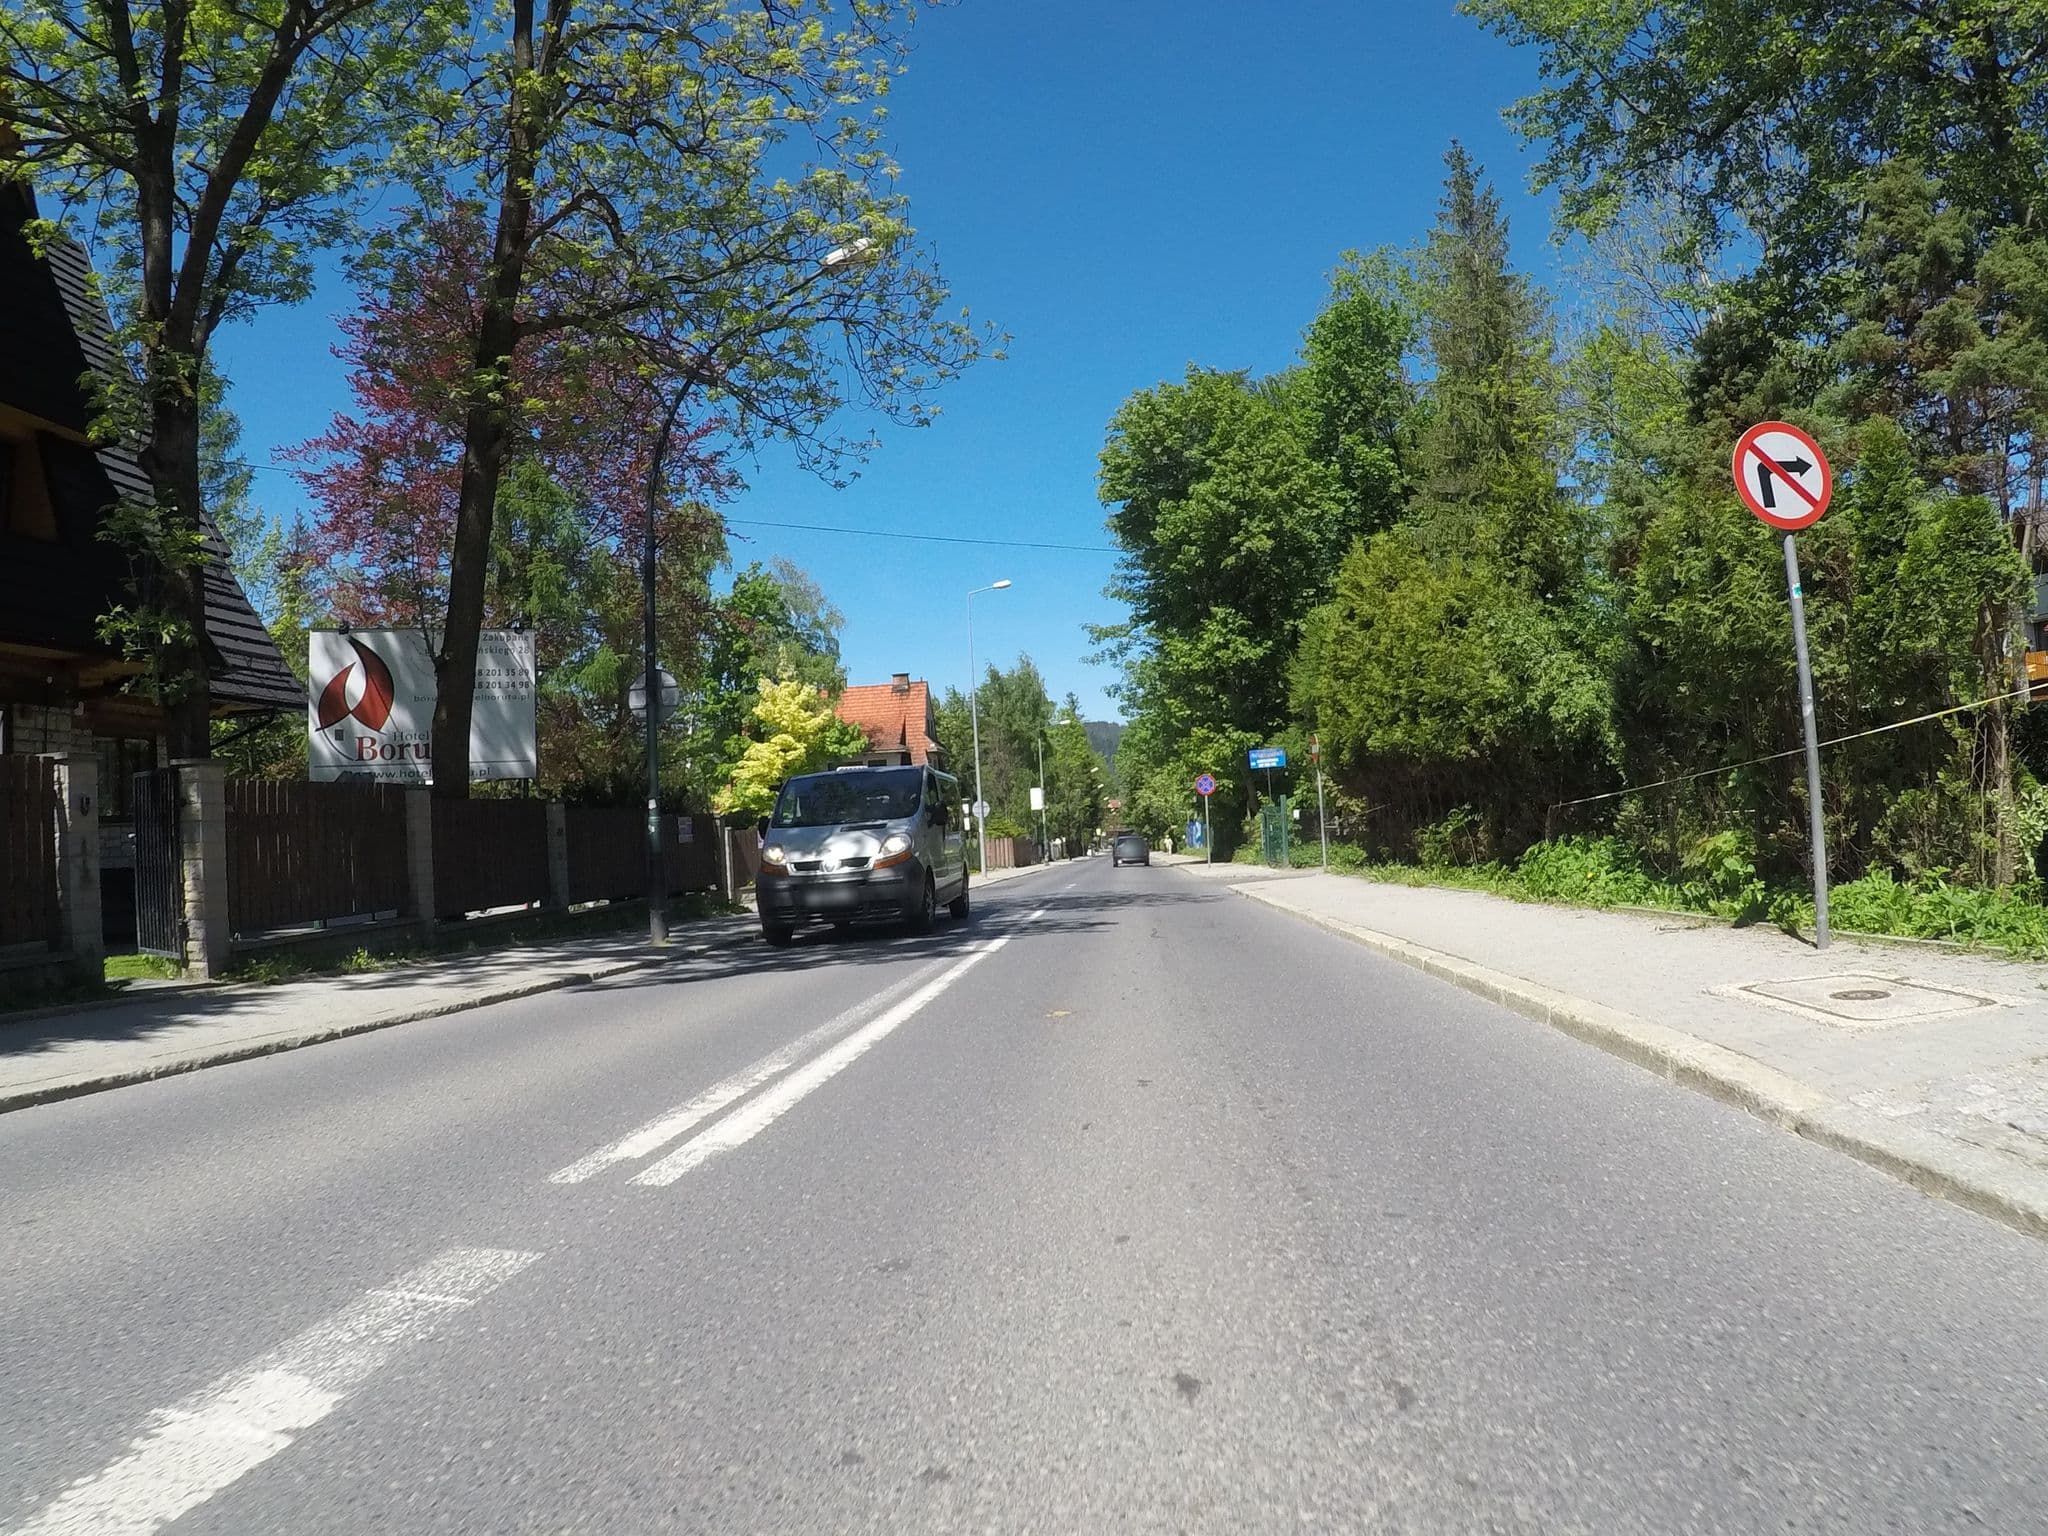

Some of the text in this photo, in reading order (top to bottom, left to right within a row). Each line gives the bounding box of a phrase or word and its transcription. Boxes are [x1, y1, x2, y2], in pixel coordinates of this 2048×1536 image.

[485, 669, 502, 677] 201
[504, 669, 516, 677] 35
[485, 681, 502, 689] 201
[504, 681, 516, 689] 34
[393, 730, 430, 741] Hotel
[355, 736, 433, 762] Boru
